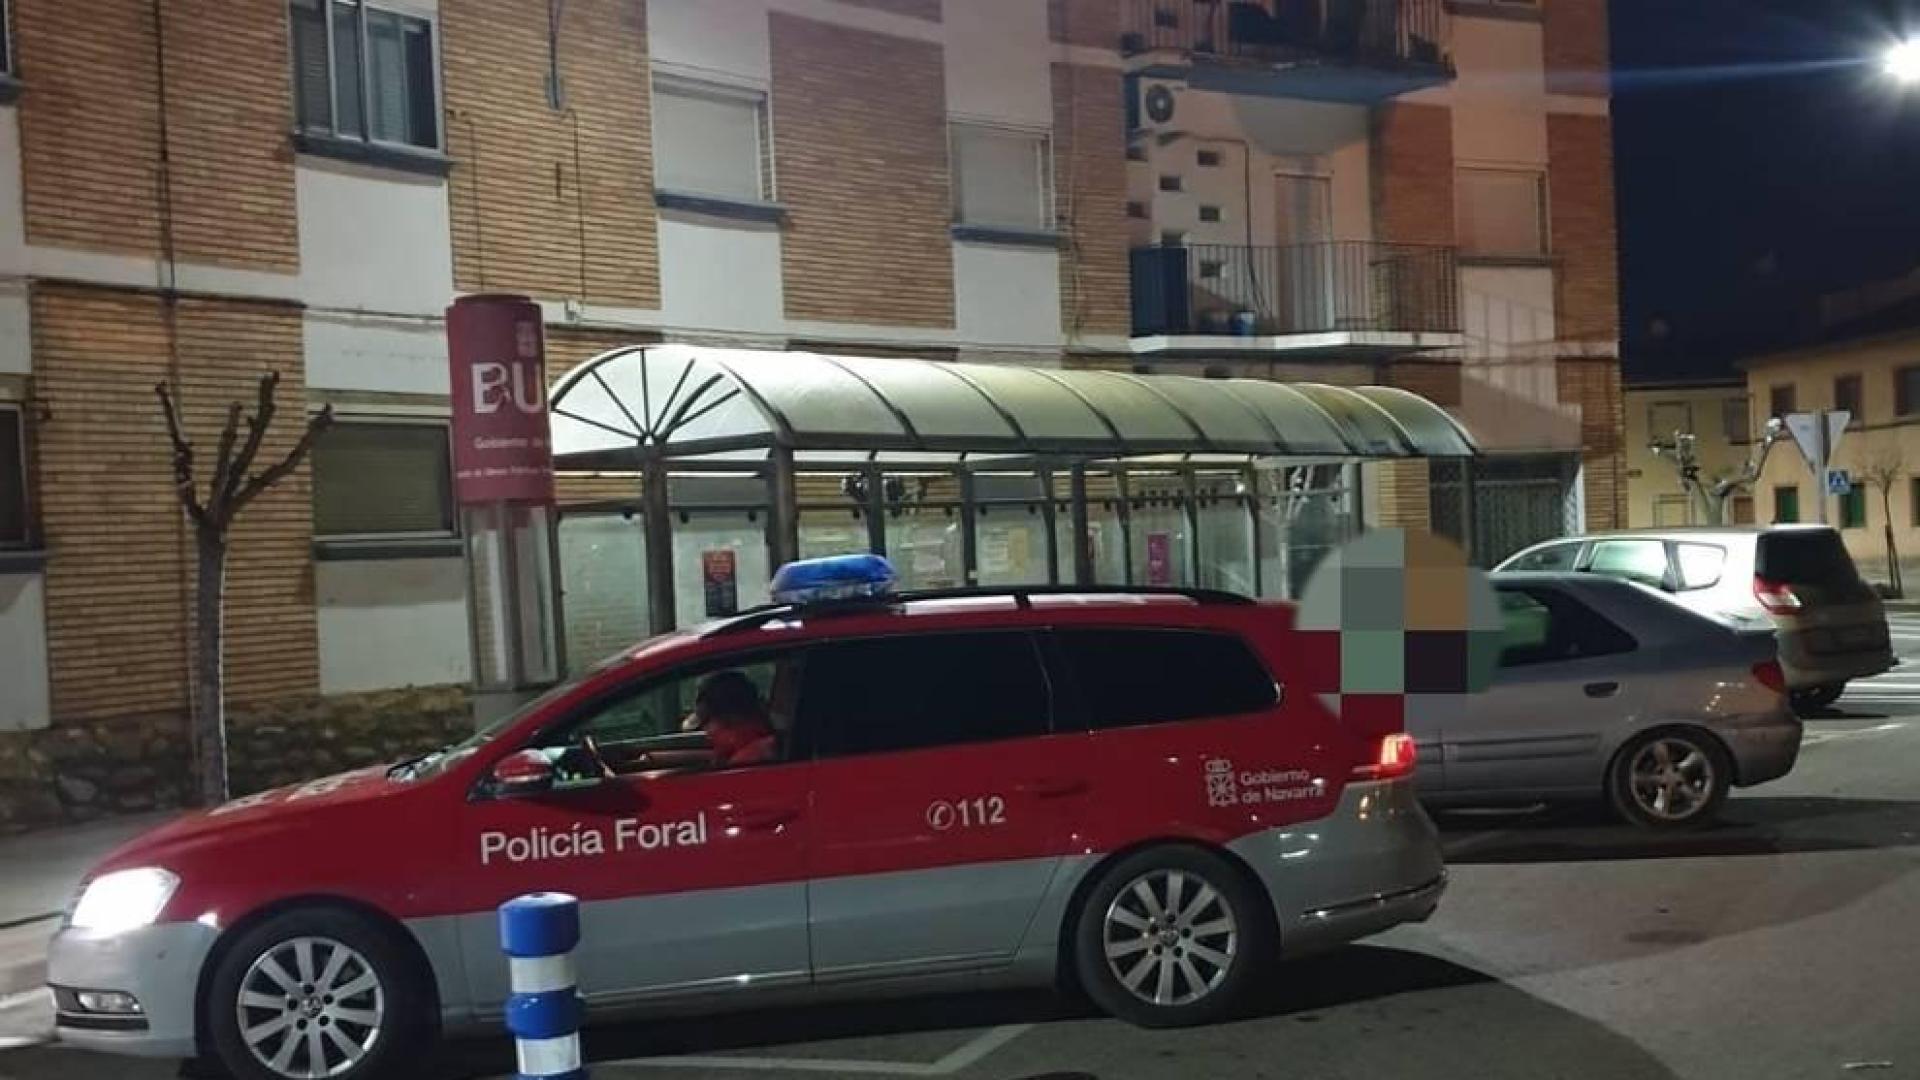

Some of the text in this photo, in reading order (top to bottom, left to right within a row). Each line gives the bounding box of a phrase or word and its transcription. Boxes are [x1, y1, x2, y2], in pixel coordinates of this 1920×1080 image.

[1240, 769, 1309, 786] Gobierno
[1241, 790, 1262, 804] de
[957, 796, 1007, 827] 112
[480, 811, 707, 865] Policía Foral
